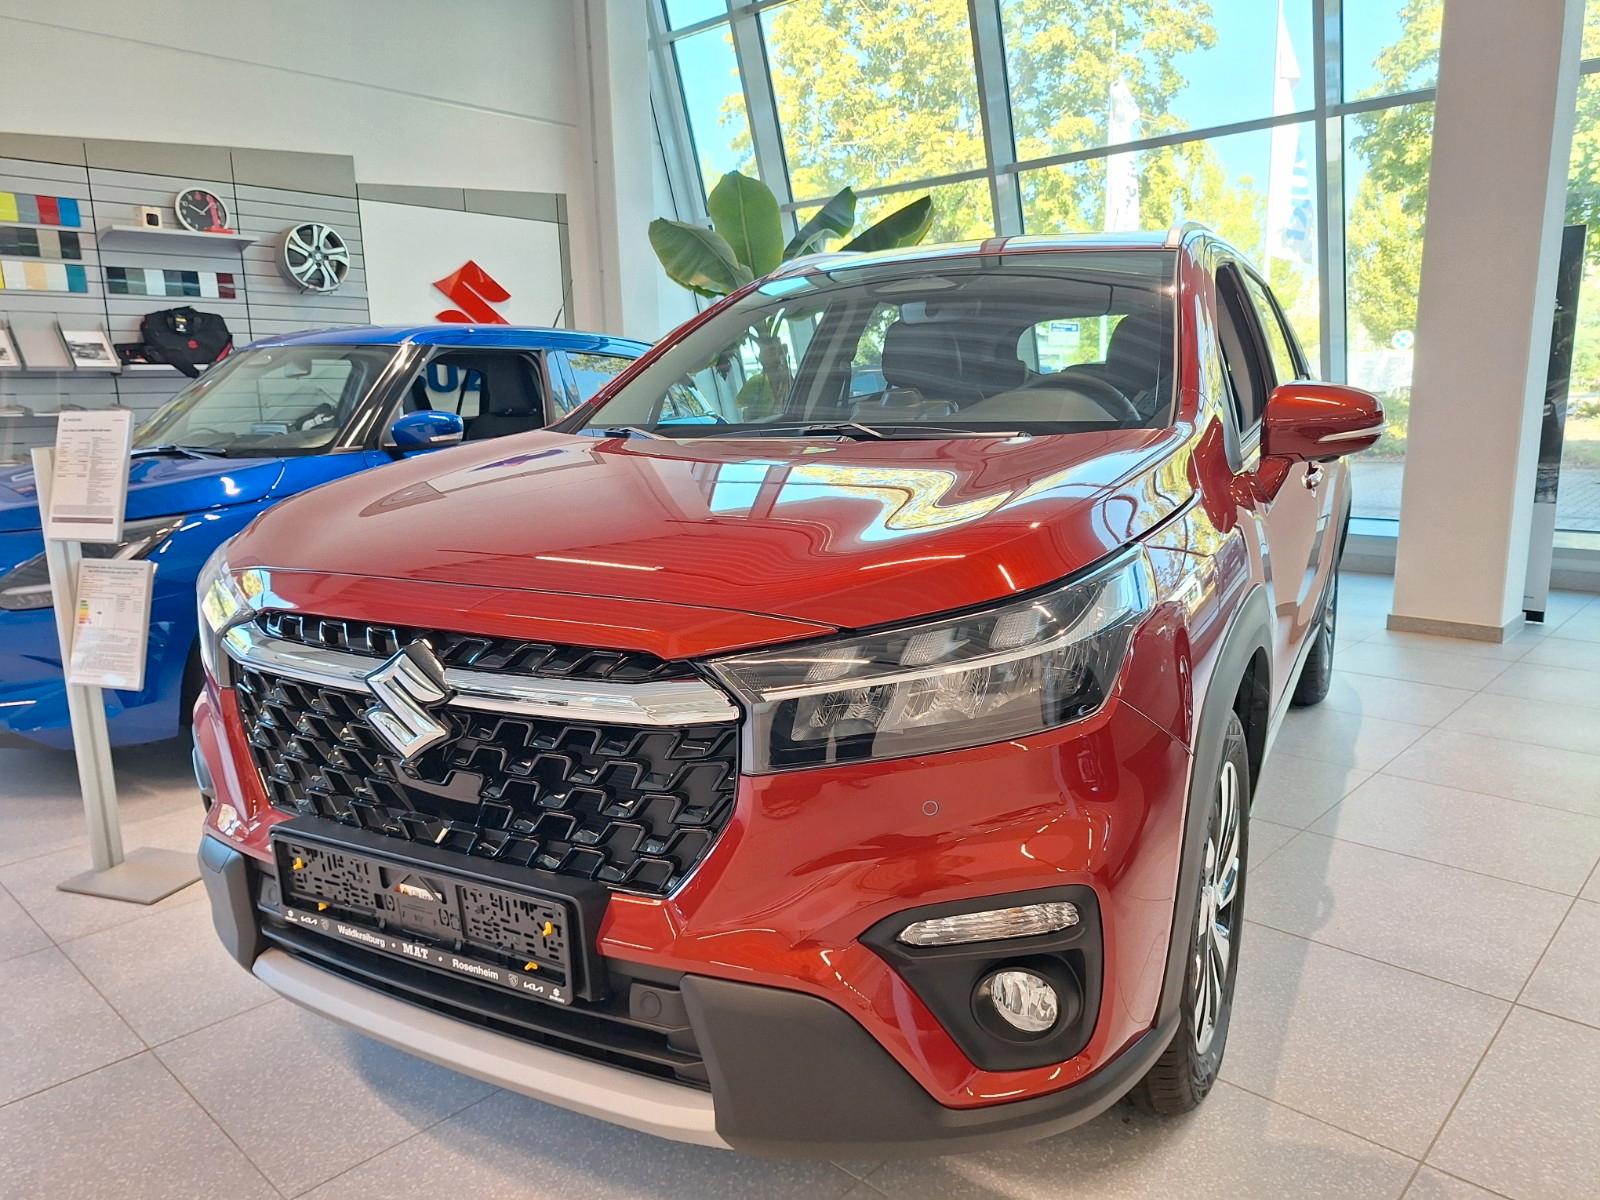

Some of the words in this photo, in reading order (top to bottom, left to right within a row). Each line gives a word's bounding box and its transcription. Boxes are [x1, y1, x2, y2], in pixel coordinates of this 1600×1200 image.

[337, 925, 386, 948] Waldkraiburg
[402, 943, 429, 959] MAT
[452, 958, 499, 980] Rosenheim
